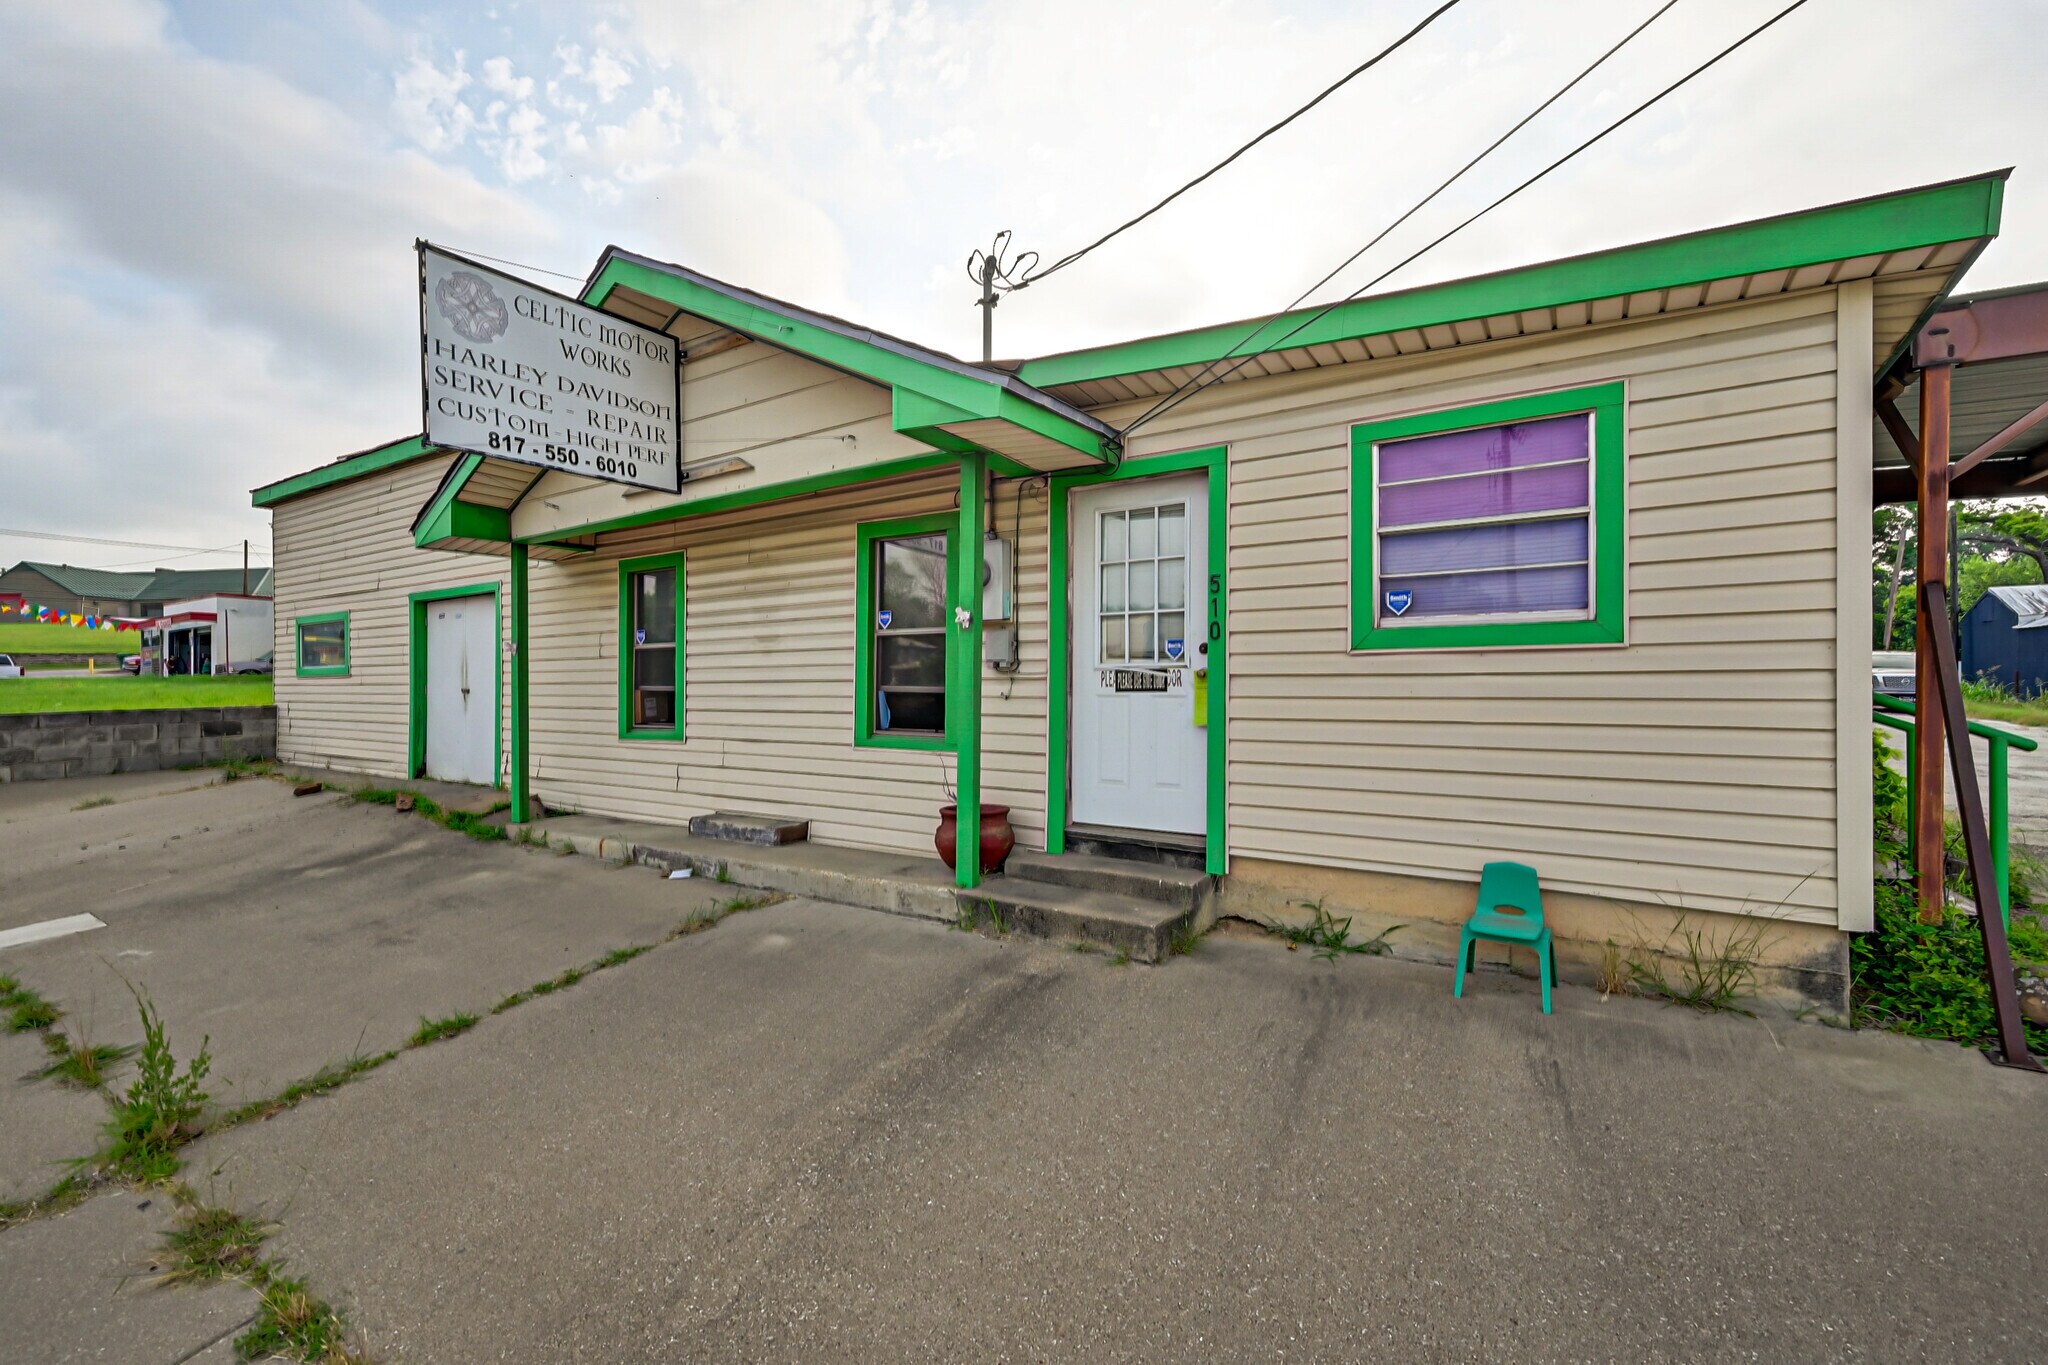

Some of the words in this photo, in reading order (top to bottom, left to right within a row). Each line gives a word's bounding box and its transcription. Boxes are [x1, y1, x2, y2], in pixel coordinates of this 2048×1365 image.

[514, 294, 592, 338] CELTIC
[600, 323, 670, 364] MOTOR
[559, 338, 632, 378] WORKS
[434, 338, 548, 385] HARLEY
[558, 375, 672, 421] DAVIDSON
[434, 365, 553, 414] SERVICE
[588, 408, 668, 445] REPAIR
[437, 396, 550, 438] CUSTOM
[566, 428, 620, 455] HIGH
[628, 444, 670, 466] PERF
[488, 431, 526, 455] 817
[545, 442, 580, 467] 550
[596, 455, 638, 479] 6010
[1210, 574, 1221, 640] 510
